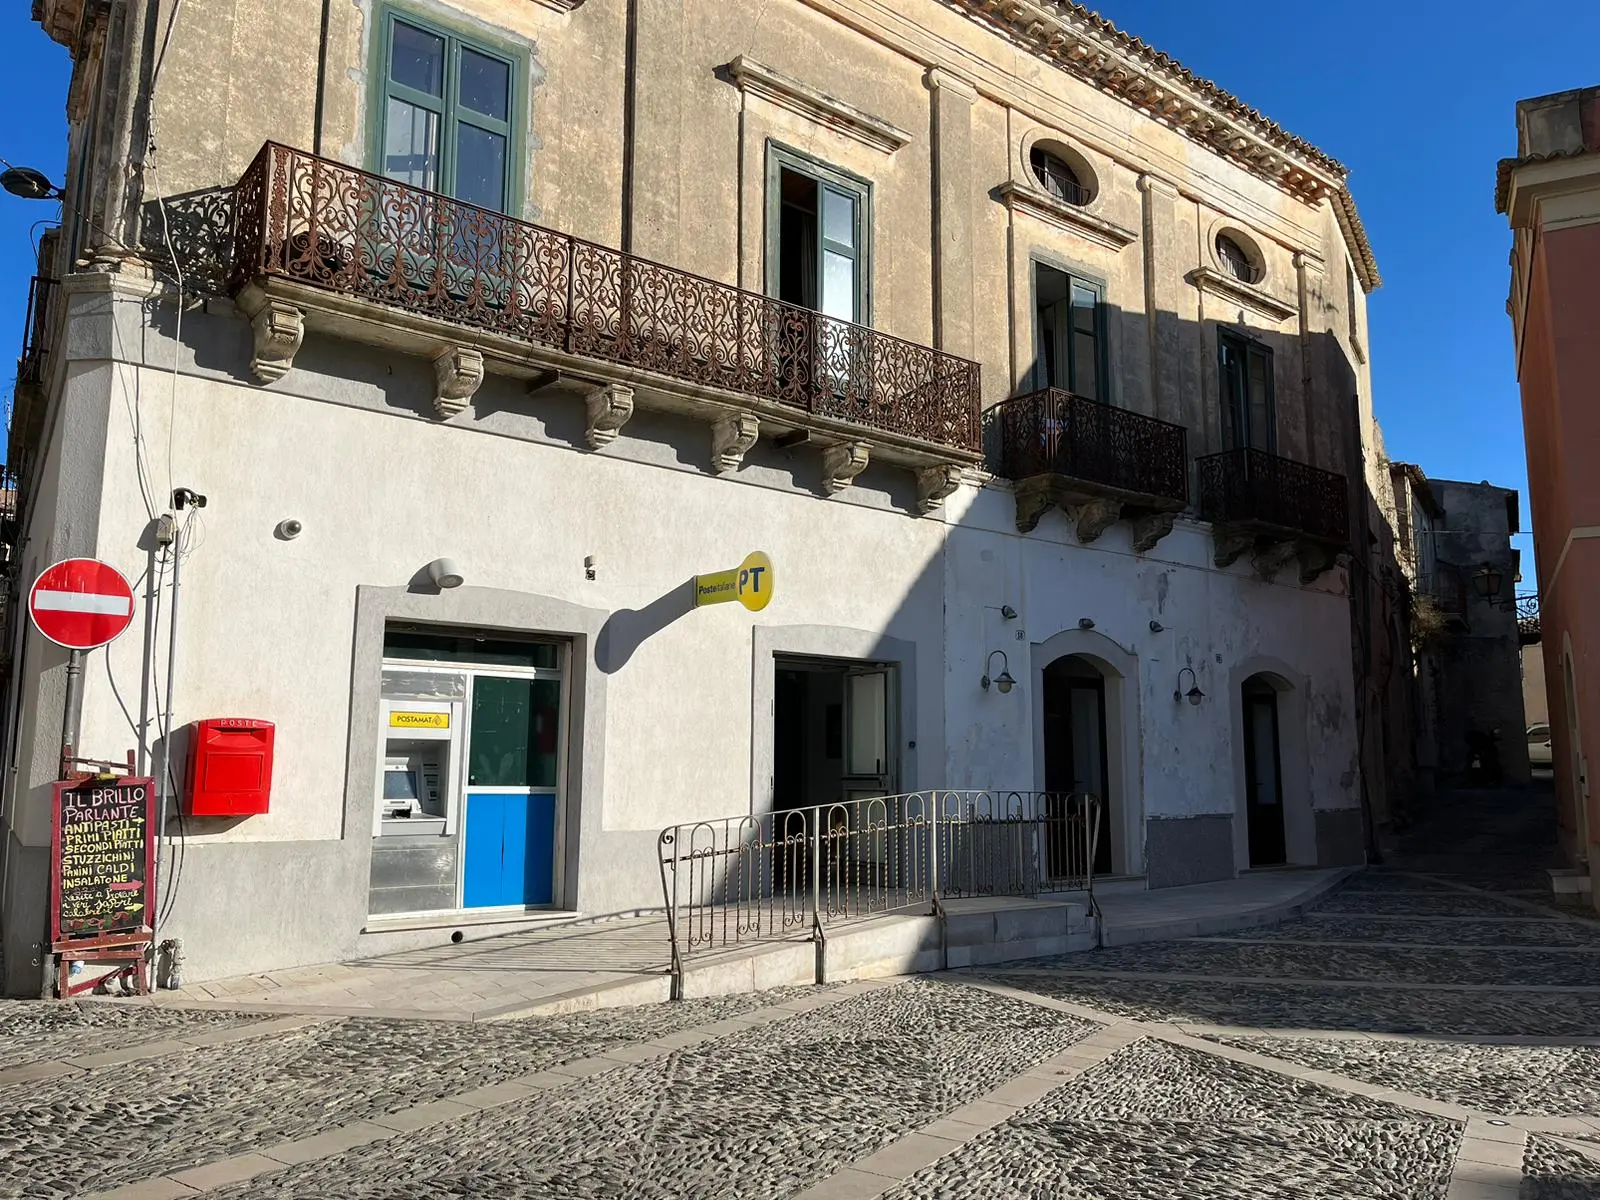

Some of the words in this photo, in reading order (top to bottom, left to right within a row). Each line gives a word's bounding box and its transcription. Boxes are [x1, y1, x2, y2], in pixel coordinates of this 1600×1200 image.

[739, 567, 765, 595] PT
[220, 719, 258, 727] POSTE
[396, 715, 433, 723] POSTAMAT
[65, 792, 87, 808] IL
[92, 787, 145, 806] BRILLO
[63, 805, 139, 824] PARLANTE
[64, 819, 129, 834] ANTIPASTI
[66, 833, 99, 845] PRIMI
[103, 825, 140, 841] PIATTI
[64, 842, 112, 854] SECONDI
[97, 862, 135, 875] CALDI
